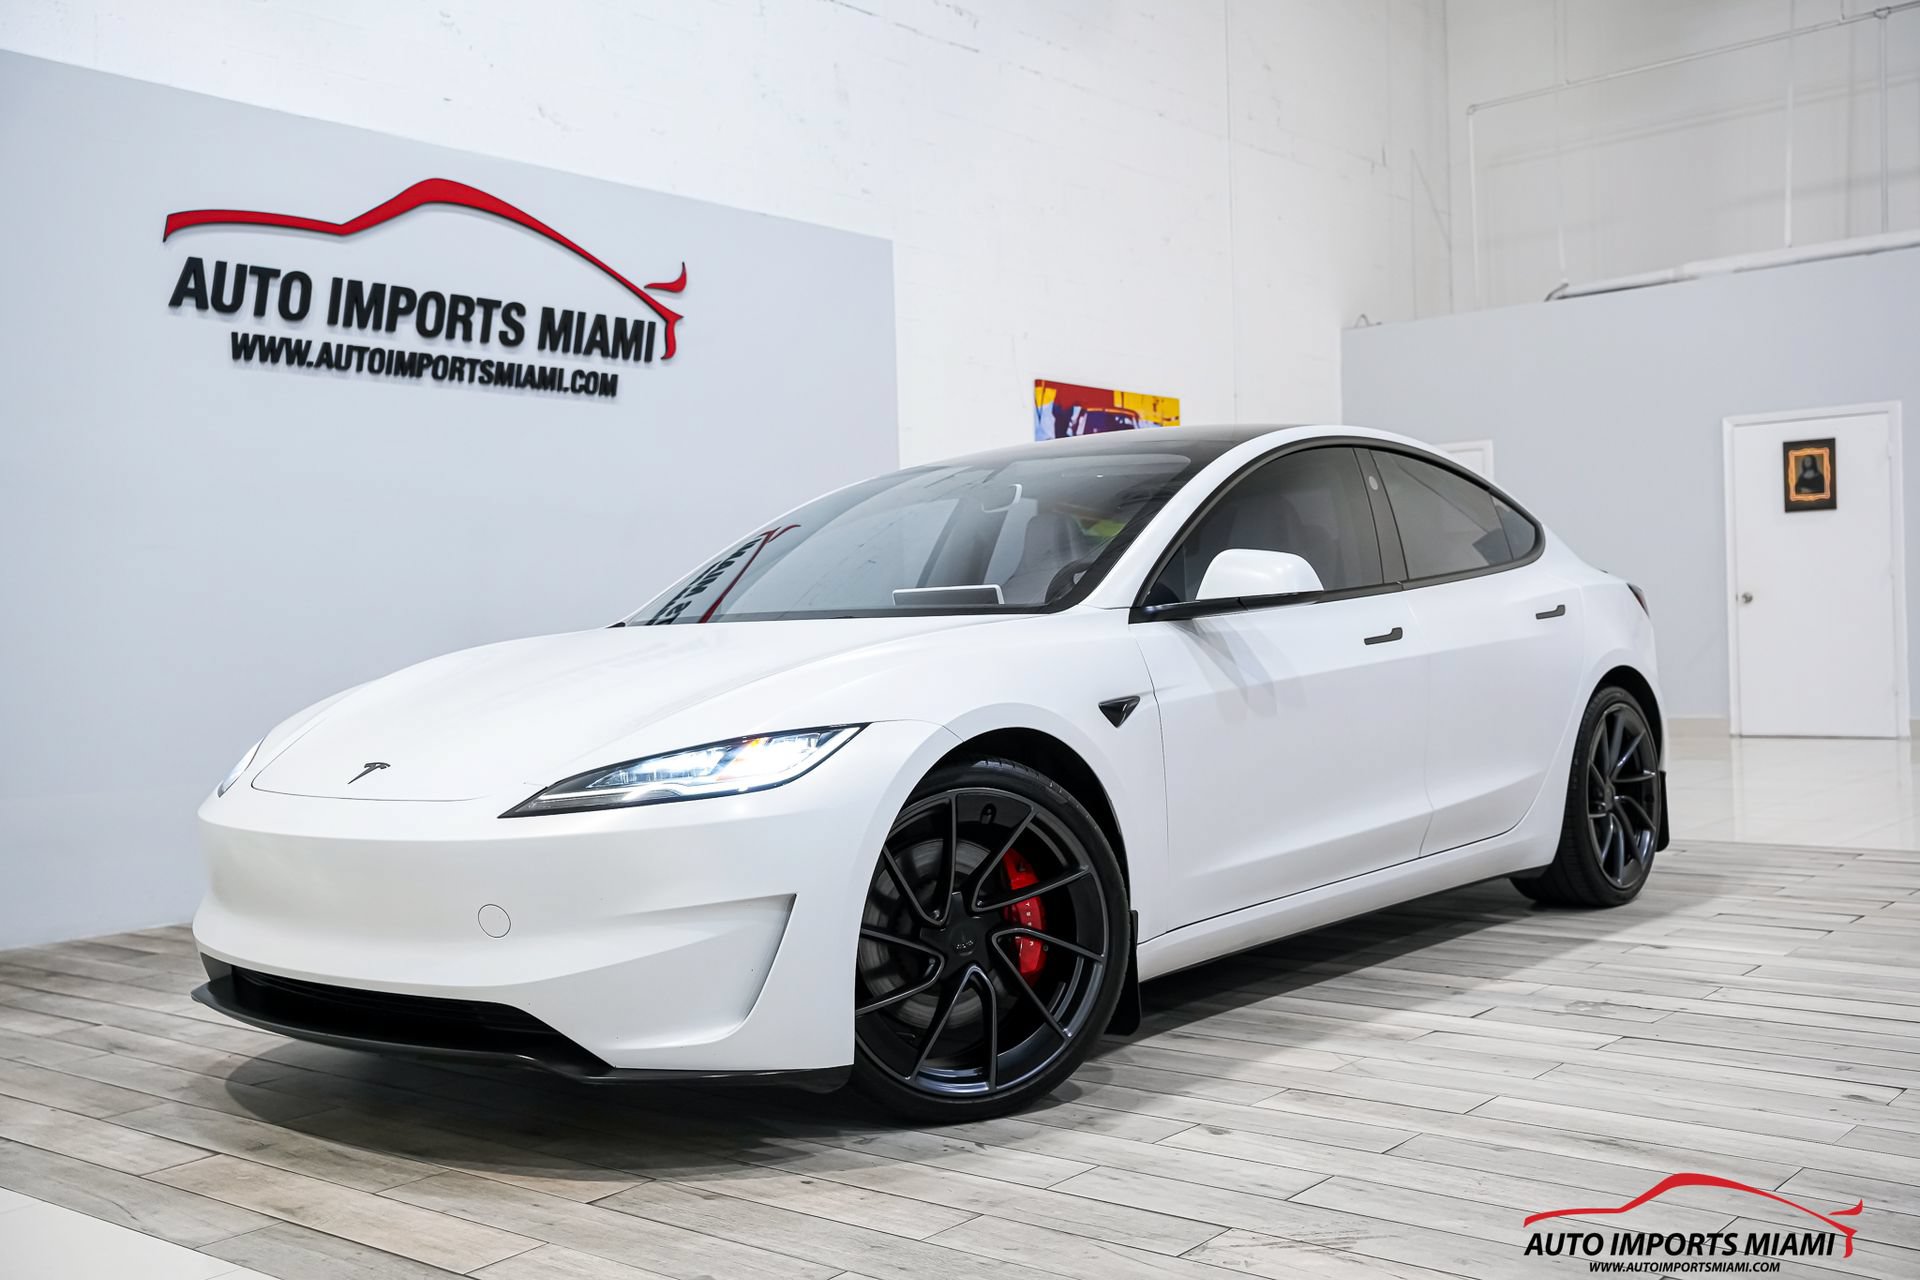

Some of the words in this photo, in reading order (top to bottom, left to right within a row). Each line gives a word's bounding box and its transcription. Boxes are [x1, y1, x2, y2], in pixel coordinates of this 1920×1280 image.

[168, 256, 313, 322] AUTO
[327, 277, 527, 348] IMPORTS
[537, 306, 657, 363] MIAMI
[231, 331, 619, 398] WWW.AUTOIMPORTSMIAMI.COM
